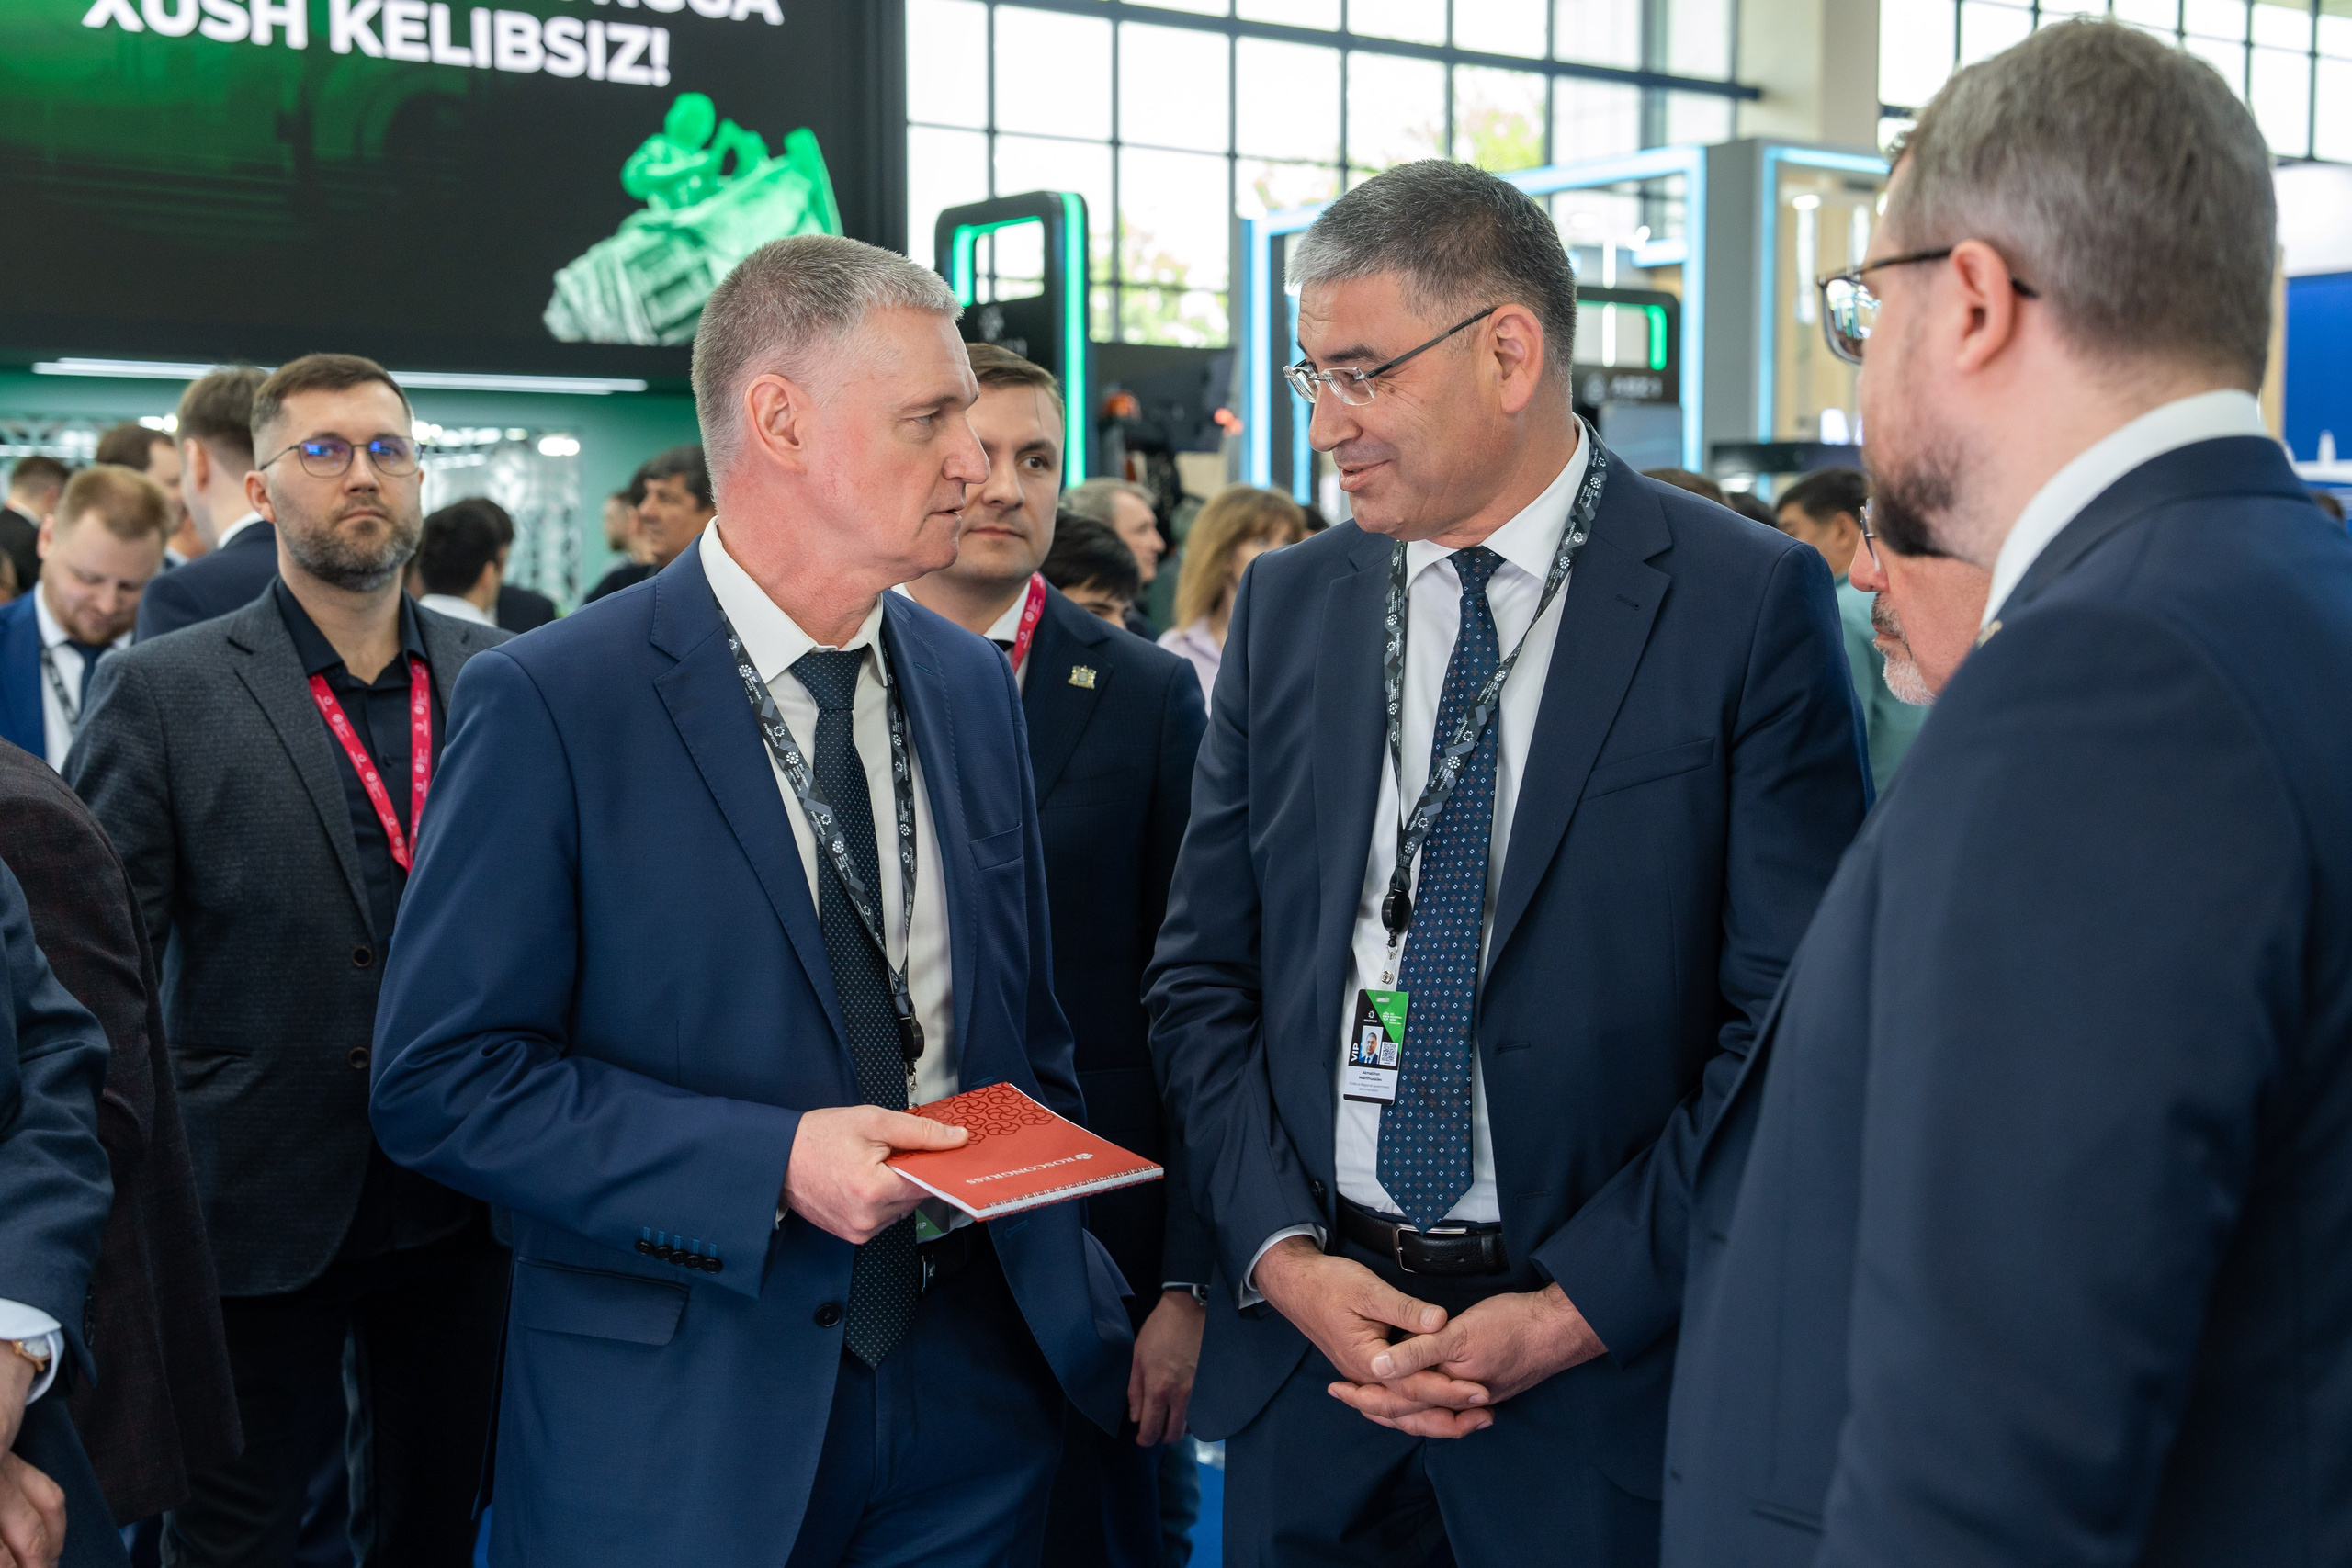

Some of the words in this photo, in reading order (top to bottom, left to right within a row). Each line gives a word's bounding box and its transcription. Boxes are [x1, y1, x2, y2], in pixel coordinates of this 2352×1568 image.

[329, 0, 672, 87] KELIBSIZ!
[1565, 521, 1576, 545] INNOPROM
[763, 722, 778, 747] INNOPROM
[1453, 719, 1468, 744] INNOPROM
[1437, 769, 1452, 792] INDUSTRIAL
[810, 810, 826, 835] INNOPROM
[1408, 807, 1422, 831] INNOPROM
[1351, 1043, 1359, 1062] VIP
[966, 1157, 1076, 1184] ROSCONGRESS
